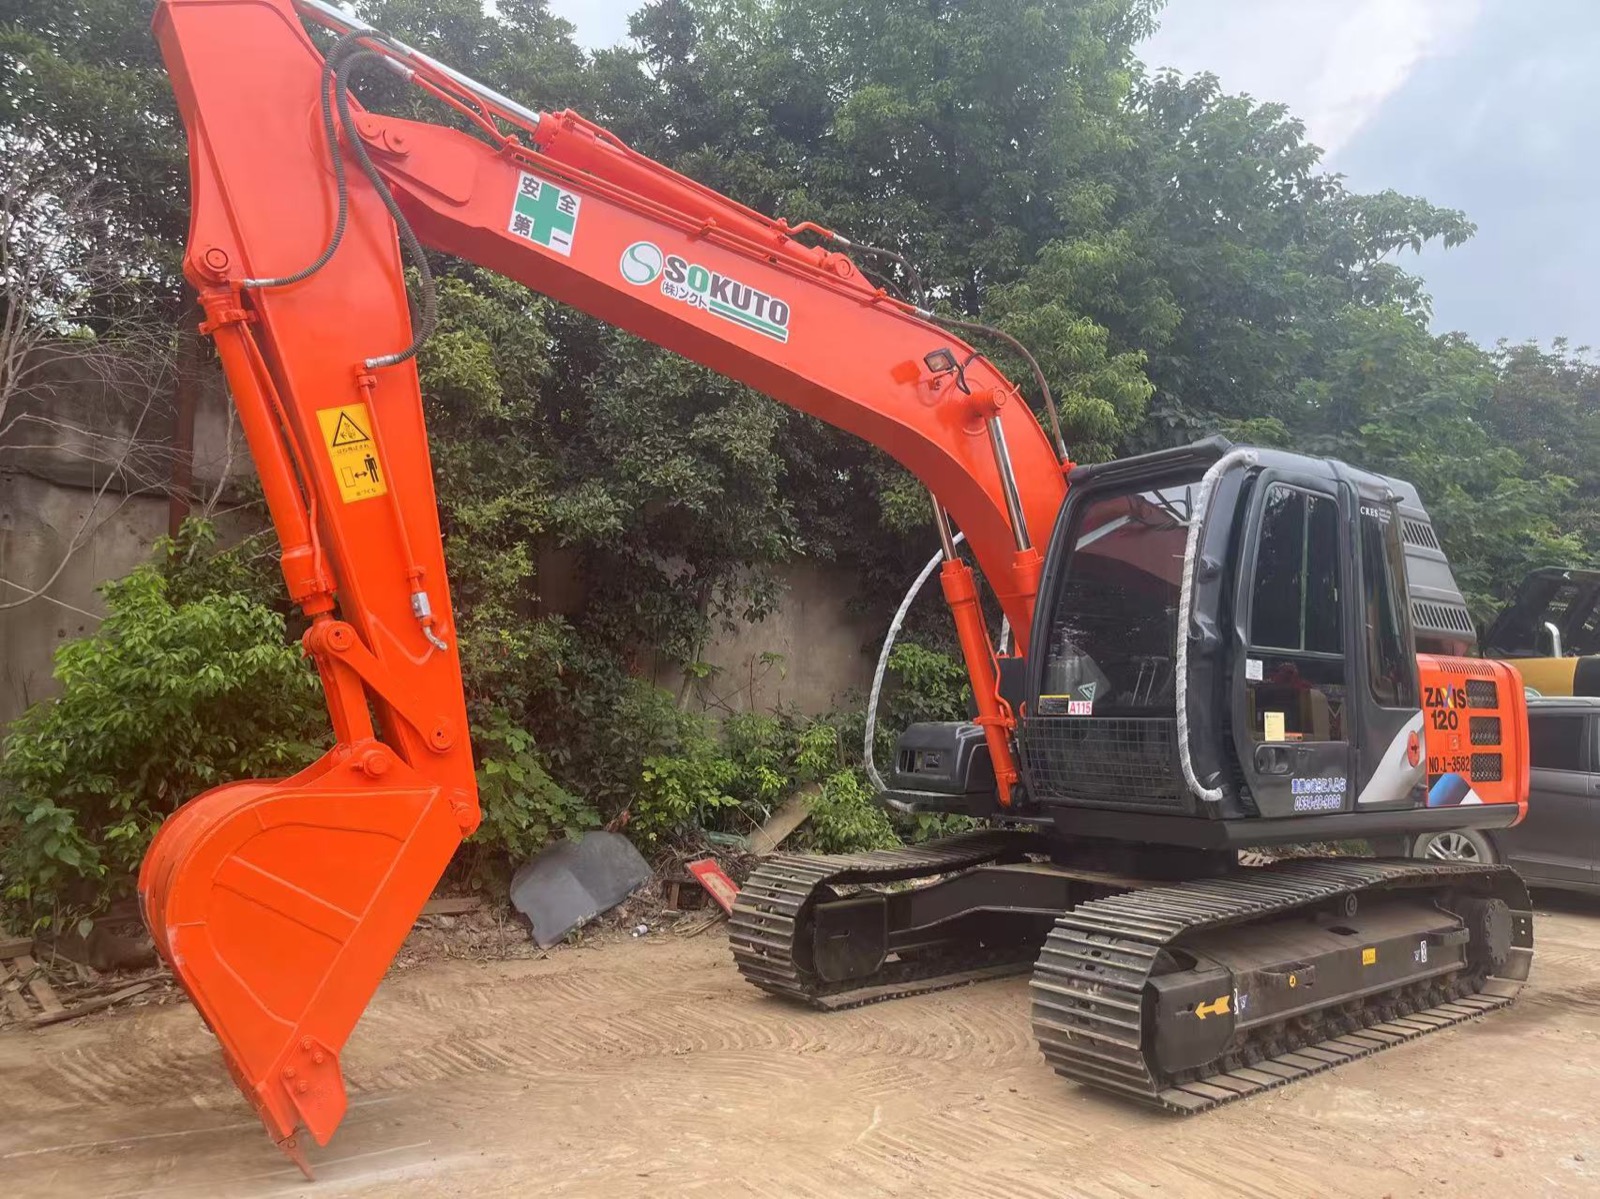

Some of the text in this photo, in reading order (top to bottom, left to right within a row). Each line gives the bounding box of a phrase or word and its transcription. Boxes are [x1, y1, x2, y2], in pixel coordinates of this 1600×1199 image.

[664, 256, 789, 326] SOKUTO
[1360, 505, 1379, 518] CRES
[1424, 684, 1467, 709] ZAXIS
[1070, 702, 1091, 714] A115
[1431, 709, 1459, 731] 120
